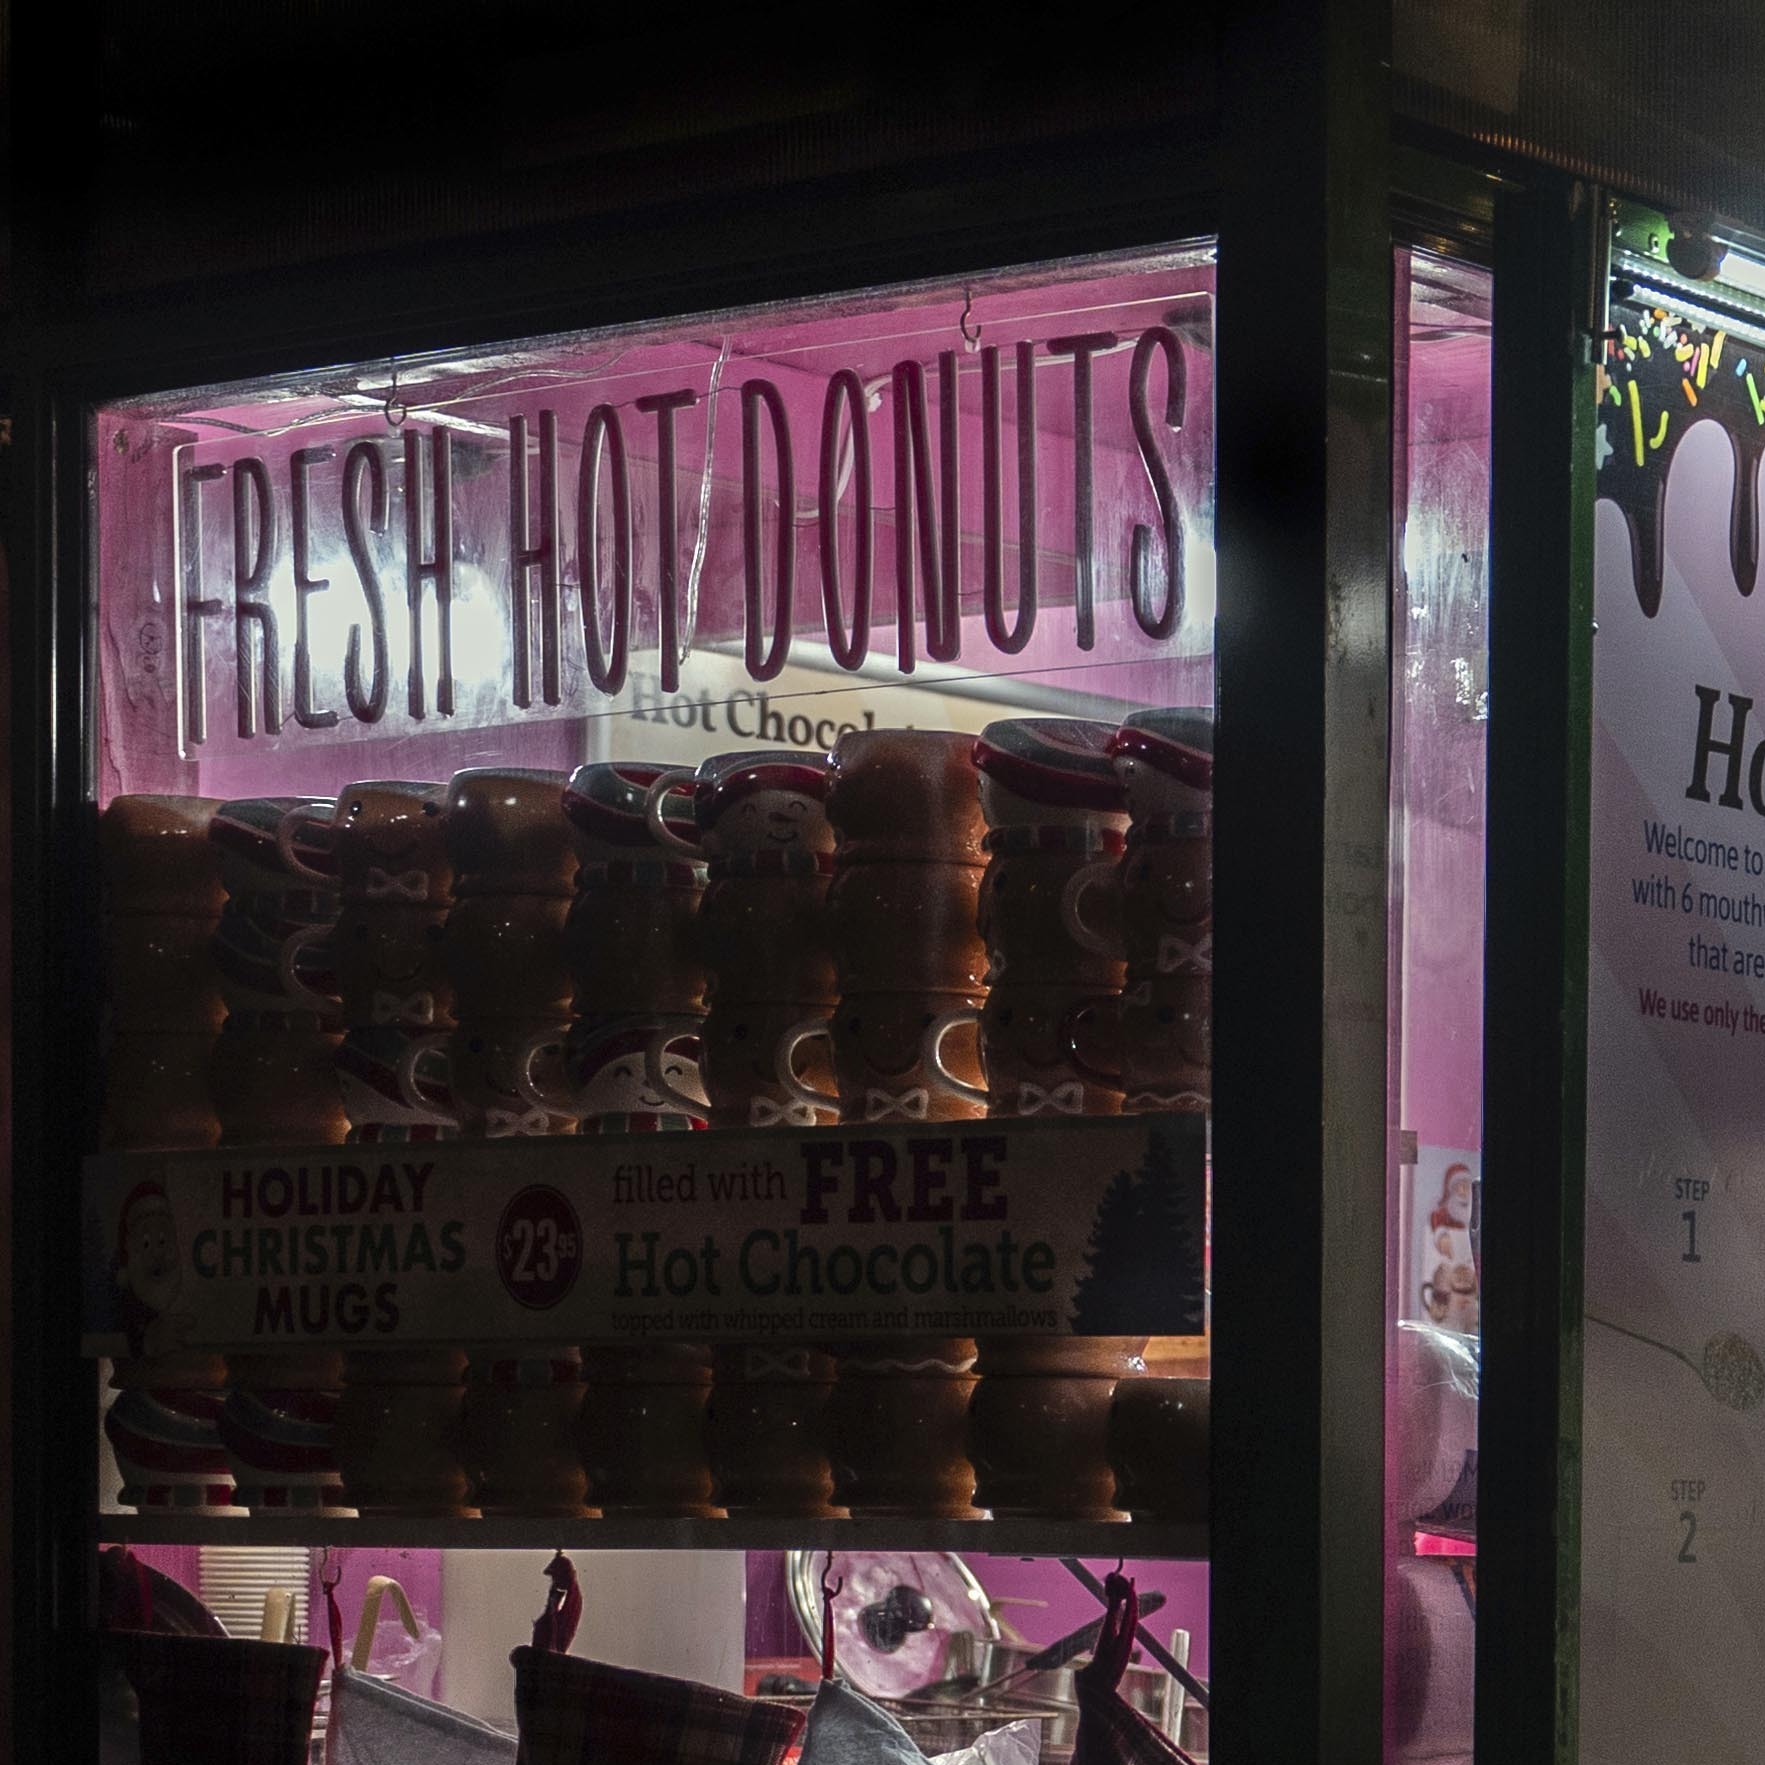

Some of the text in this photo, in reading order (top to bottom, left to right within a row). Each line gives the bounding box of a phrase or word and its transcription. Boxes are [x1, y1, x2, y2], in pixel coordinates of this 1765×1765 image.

[184, 326, 1188, 746] FRESH HOT DONUTS
[627, 670, 718, 733] Hot
[1643, 819, 1739, 872] Welcome
[1744, 845, 1764, 877] to
[1632, 873, 1676, 911] with
[1681, 881, 1694, 915] 6
[1688, 933, 1729, 973] that
[1638, 987, 1668, 1019] We
[1670, 999, 1700, 1024] use
[1703, 1001, 1740, 1038] only
[222, 1163, 436, 1219] HOLIDAY
[612, 1135, 1009, 1226] filled with FREE
[1674, 1177, 1712, 1202] STEP
[193, 1220, 468, 1280] CHRISTMAS
[613, 1225, 1057, 1298] Hot Chocolate
[1681, 1209, 1702, 1263] 1
[253, 1282, 402, 1336] MUGS
[612, 1304, 1059, 1336] topped with whipped cream and marshmallows
[1671, 1480, 1706, 1502] STEP
[1678, 1511, 1698, 1563] 2
